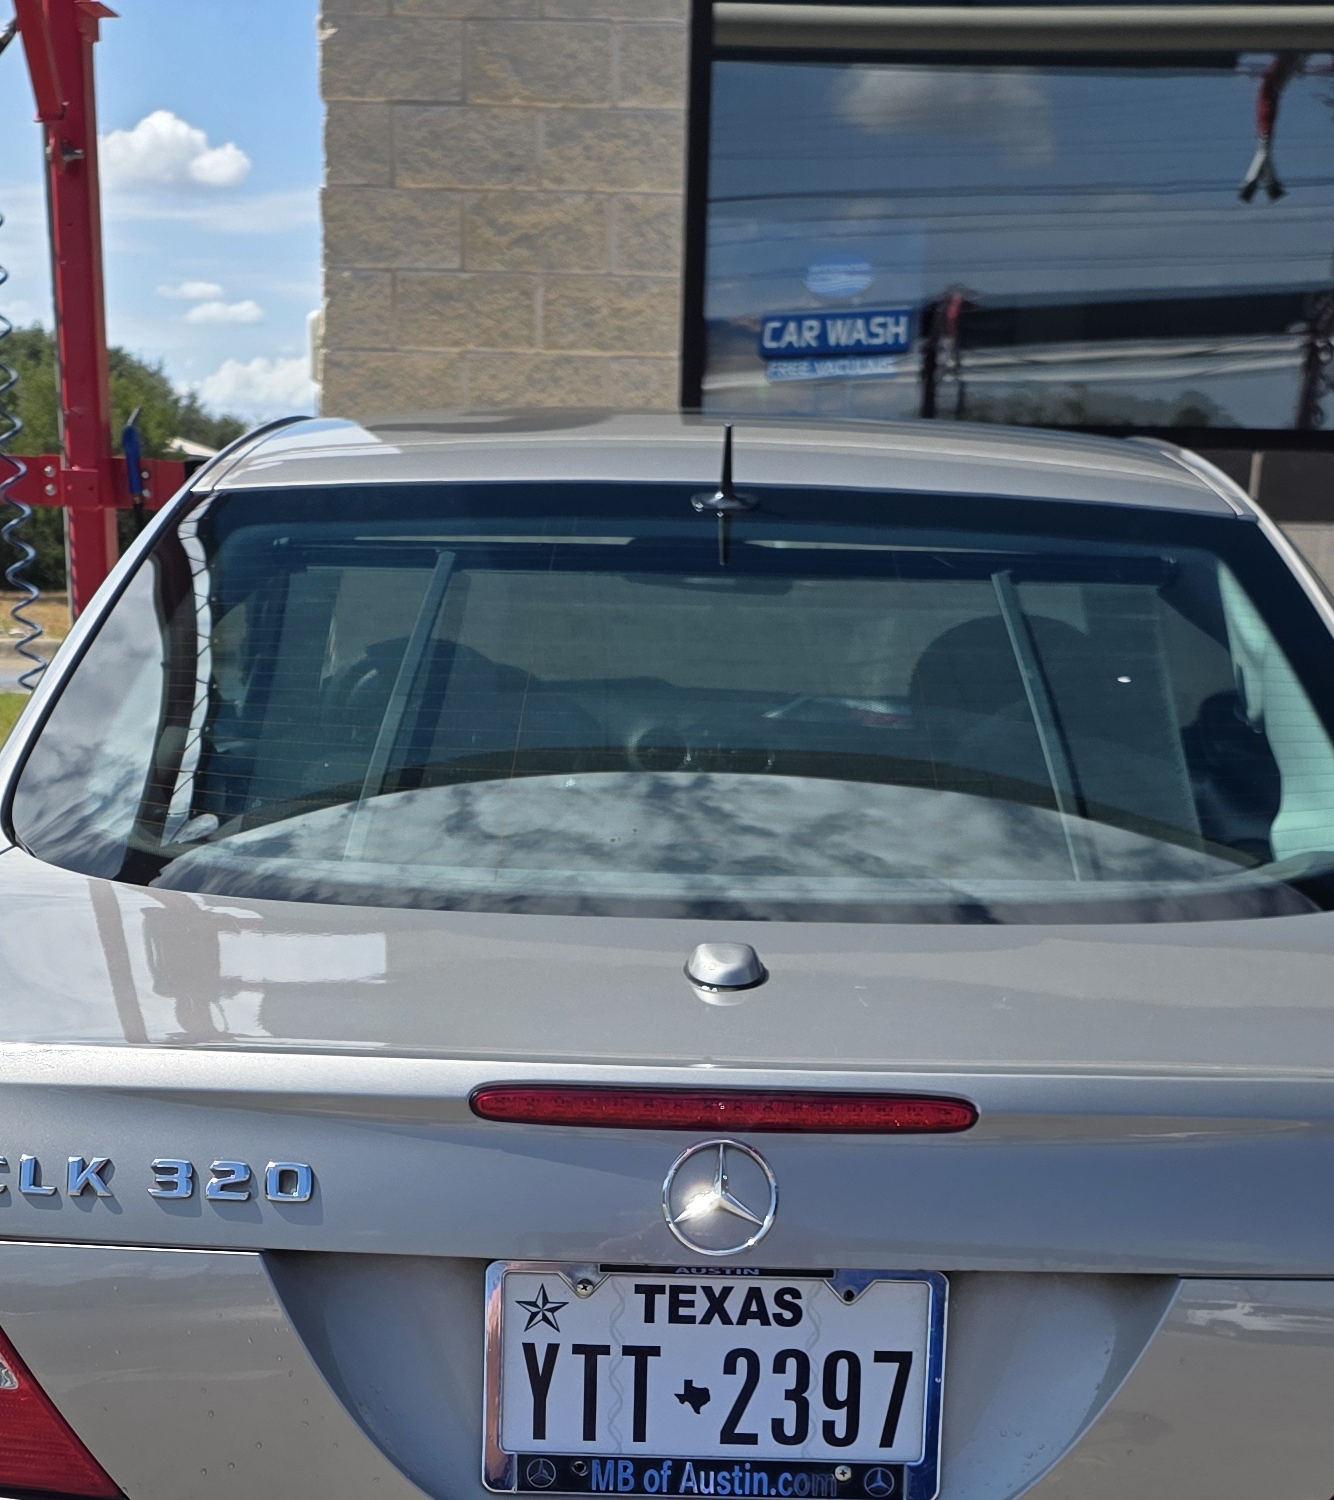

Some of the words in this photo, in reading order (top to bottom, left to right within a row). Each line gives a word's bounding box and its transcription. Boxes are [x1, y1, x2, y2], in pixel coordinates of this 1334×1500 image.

[762, 319, 821, 348] CAR
[825, 315, 907, 346] WASH
[147, 1157, 313, 1202] 320
[674, 1267, 760, 1276] AUSTIN
[634, 1283, 803, 1328] TEXAS
[522, 1342, 661, 1443] YTT
[719, 1347, 913, 1449] 2397
[591, 1459, 635, 1492] MB
[643, 1460, 672, 1493] of
[678, 1461, 837, 1497] Austin.com
